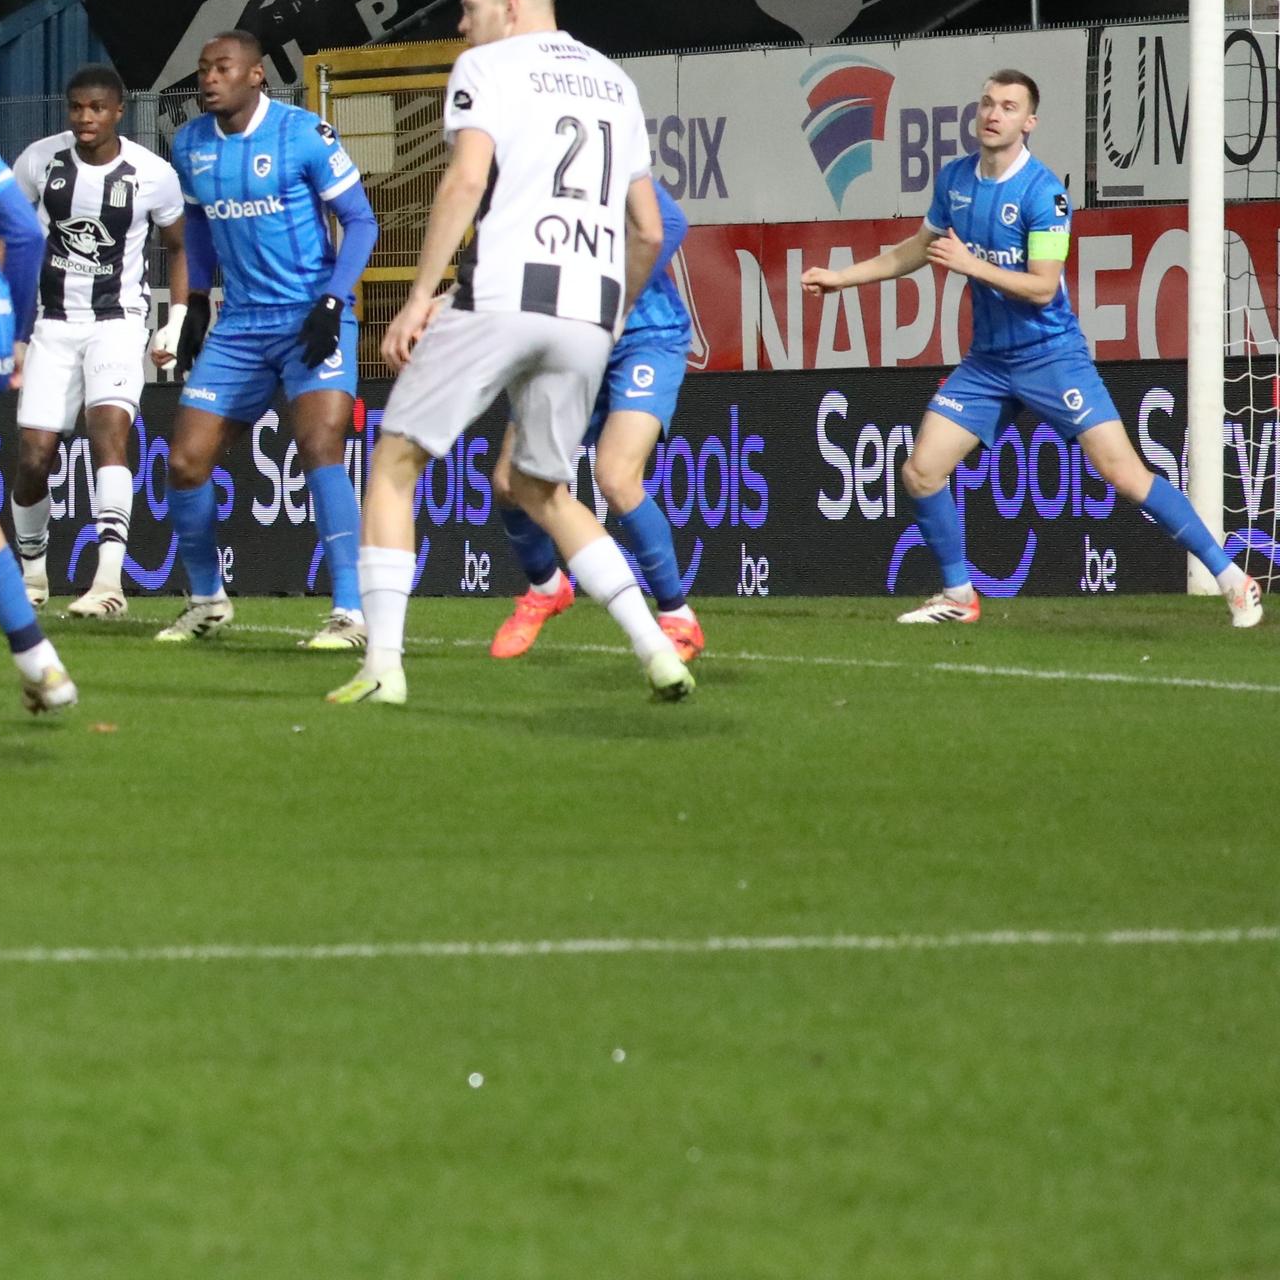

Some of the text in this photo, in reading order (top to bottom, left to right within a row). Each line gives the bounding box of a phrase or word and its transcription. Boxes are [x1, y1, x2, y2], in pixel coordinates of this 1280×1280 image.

[530, 72, 625, 105] SCHEIDLER
[553, 115, 613, 207] 21
[51, 255, 114, 277] NAPOLEON
[460, 540, 491, 592] .be
[737, 543, 769, 597] .be
[1080, 534, 1117, 593] .be
